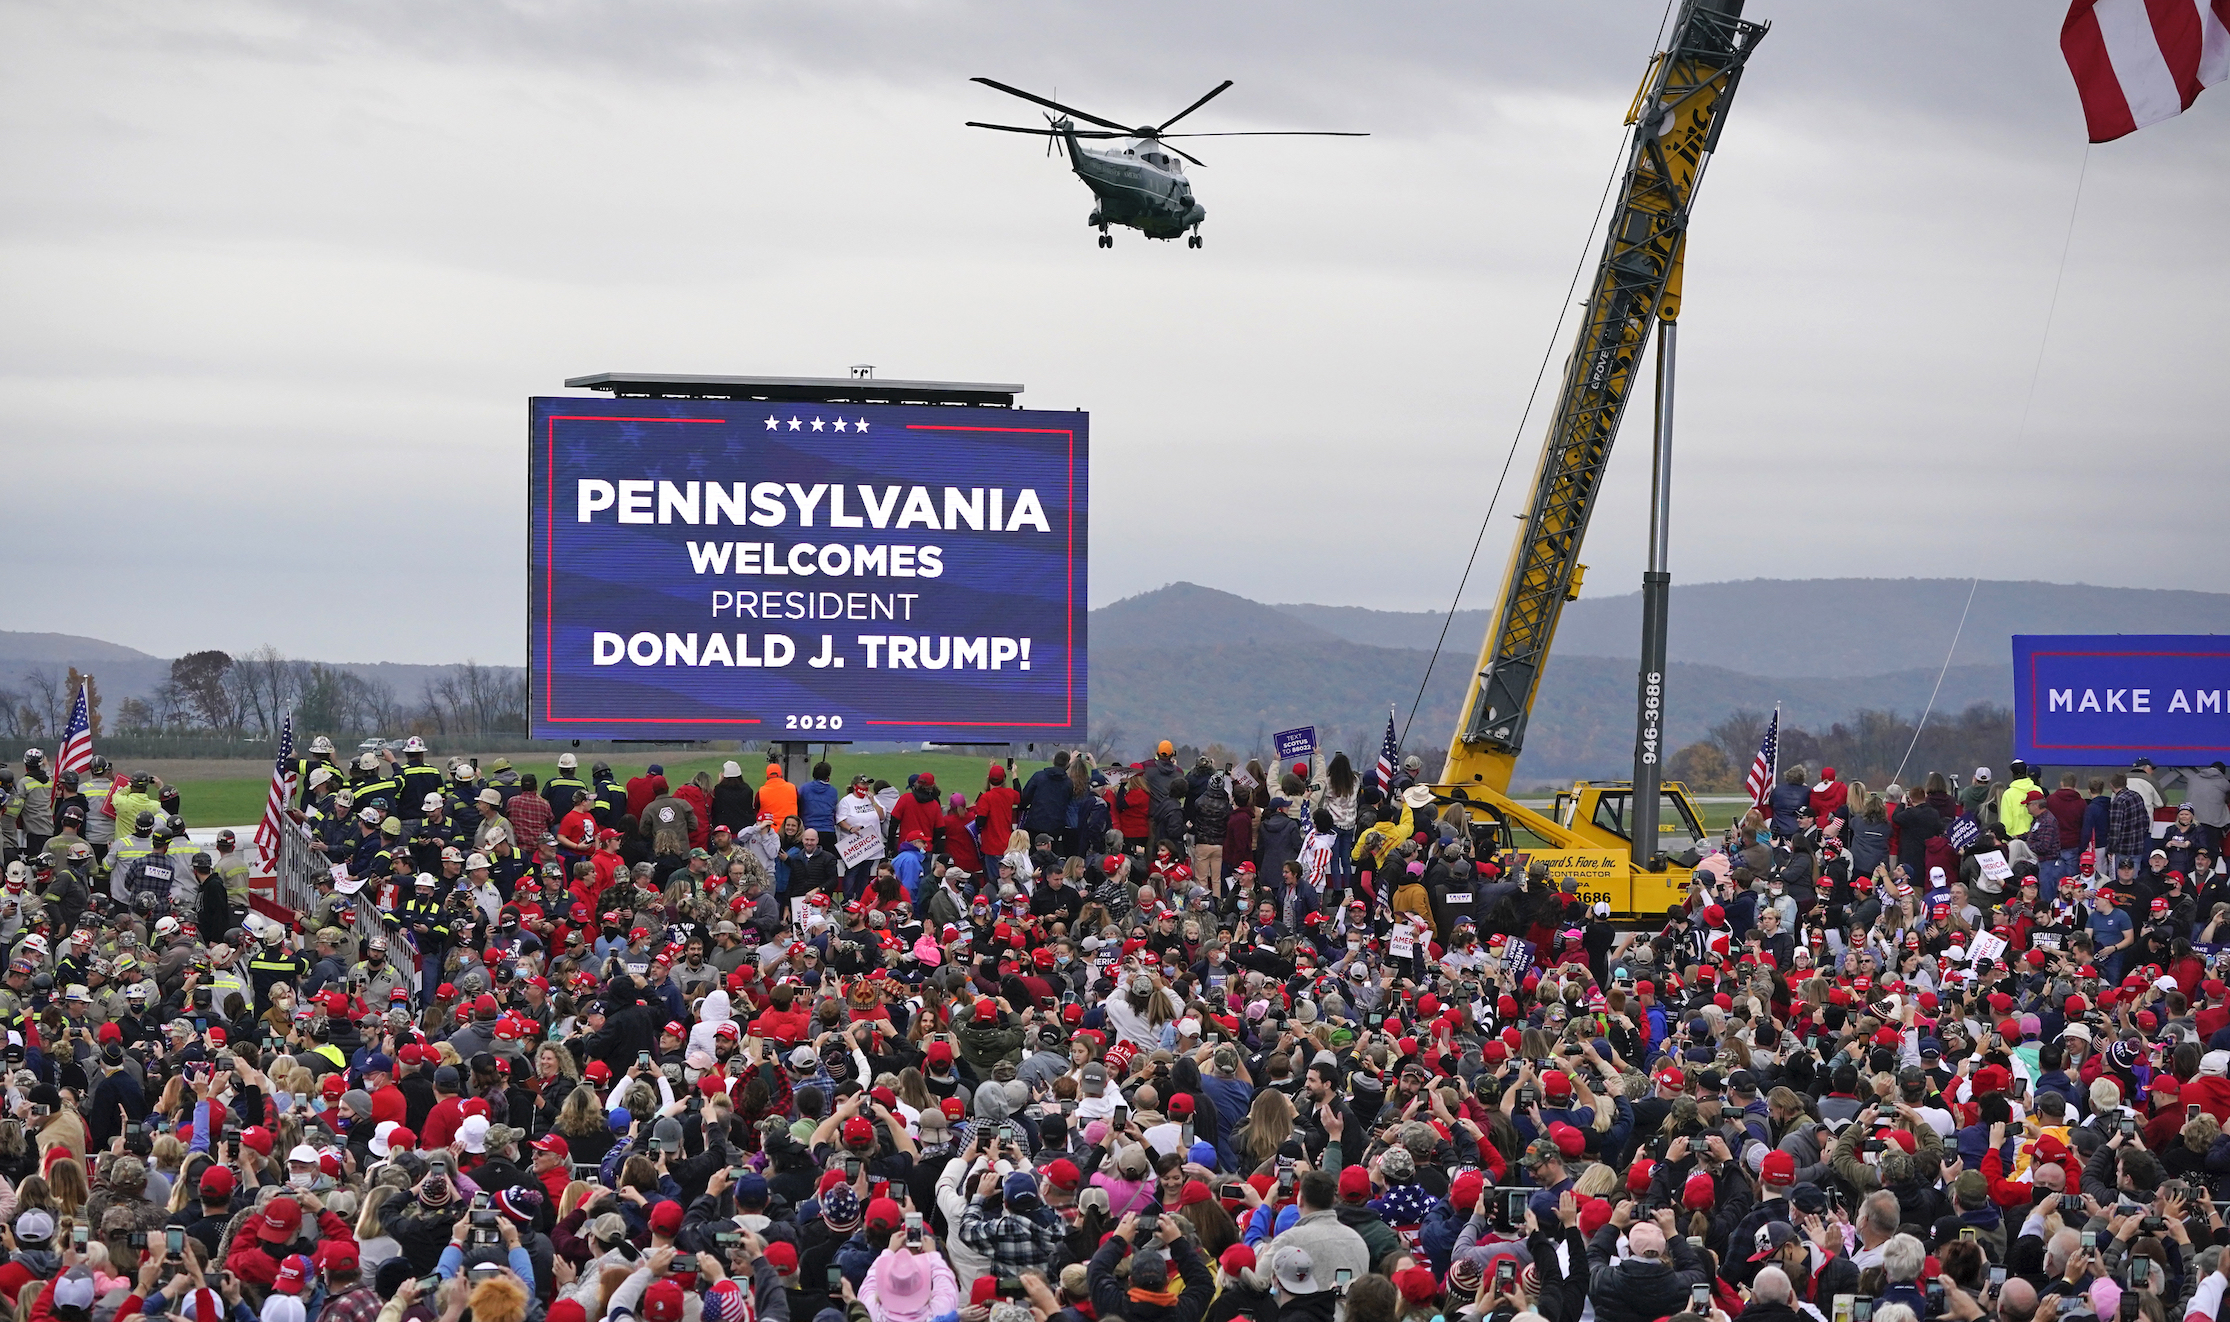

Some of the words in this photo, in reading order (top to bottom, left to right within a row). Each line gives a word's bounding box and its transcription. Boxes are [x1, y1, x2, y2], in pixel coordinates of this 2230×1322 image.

[1591, 350, 1609, 390] GROVE
[577, 478, 1050, 533] PENNSYLVANIA
[687, 541, 943, 578] WELCOMES
[712, 590, 919, 621] PRESIDENT
[593, 631, 796, 669] DONALD
[808, 634, 844, 670] J.
[858, 635, 1032, 671] TRUMP!
[2049, 688, 2151, 713] MAKE
[2167, 689, 2230, 714] AM
[786, 715, 843, 731] 2020
[1642, 671, 1661, 765] 946-3686
[1283, 739, 1308, 748] SCOTUS
[1950, 820, 1976, 844] AMERICA
[1953, 820, 1964, 832] MAKE
[1964, 826, 1978, 840] AGAIN
[842, 834, 877, 858] AMERICA
[848, 834, 864, 846] MAKE
[846, 850, 864, 862] GREAT
[864, 840, 880, 852] AGAIN
[148, 867, 170, 875] TRUMP
[1566, 856, 1573, 868] S.
[1575, 856, 1600, 869] Fiore,
[1602, 856, 1616, 868] Inc.
[1971, 943, 1982, 960] MAKE
[1988, 940, 2000, 958] AGAIN
[1518, 954, 1528, 972] MAKE
[1106, 1055, 1122, 1066] 2020
